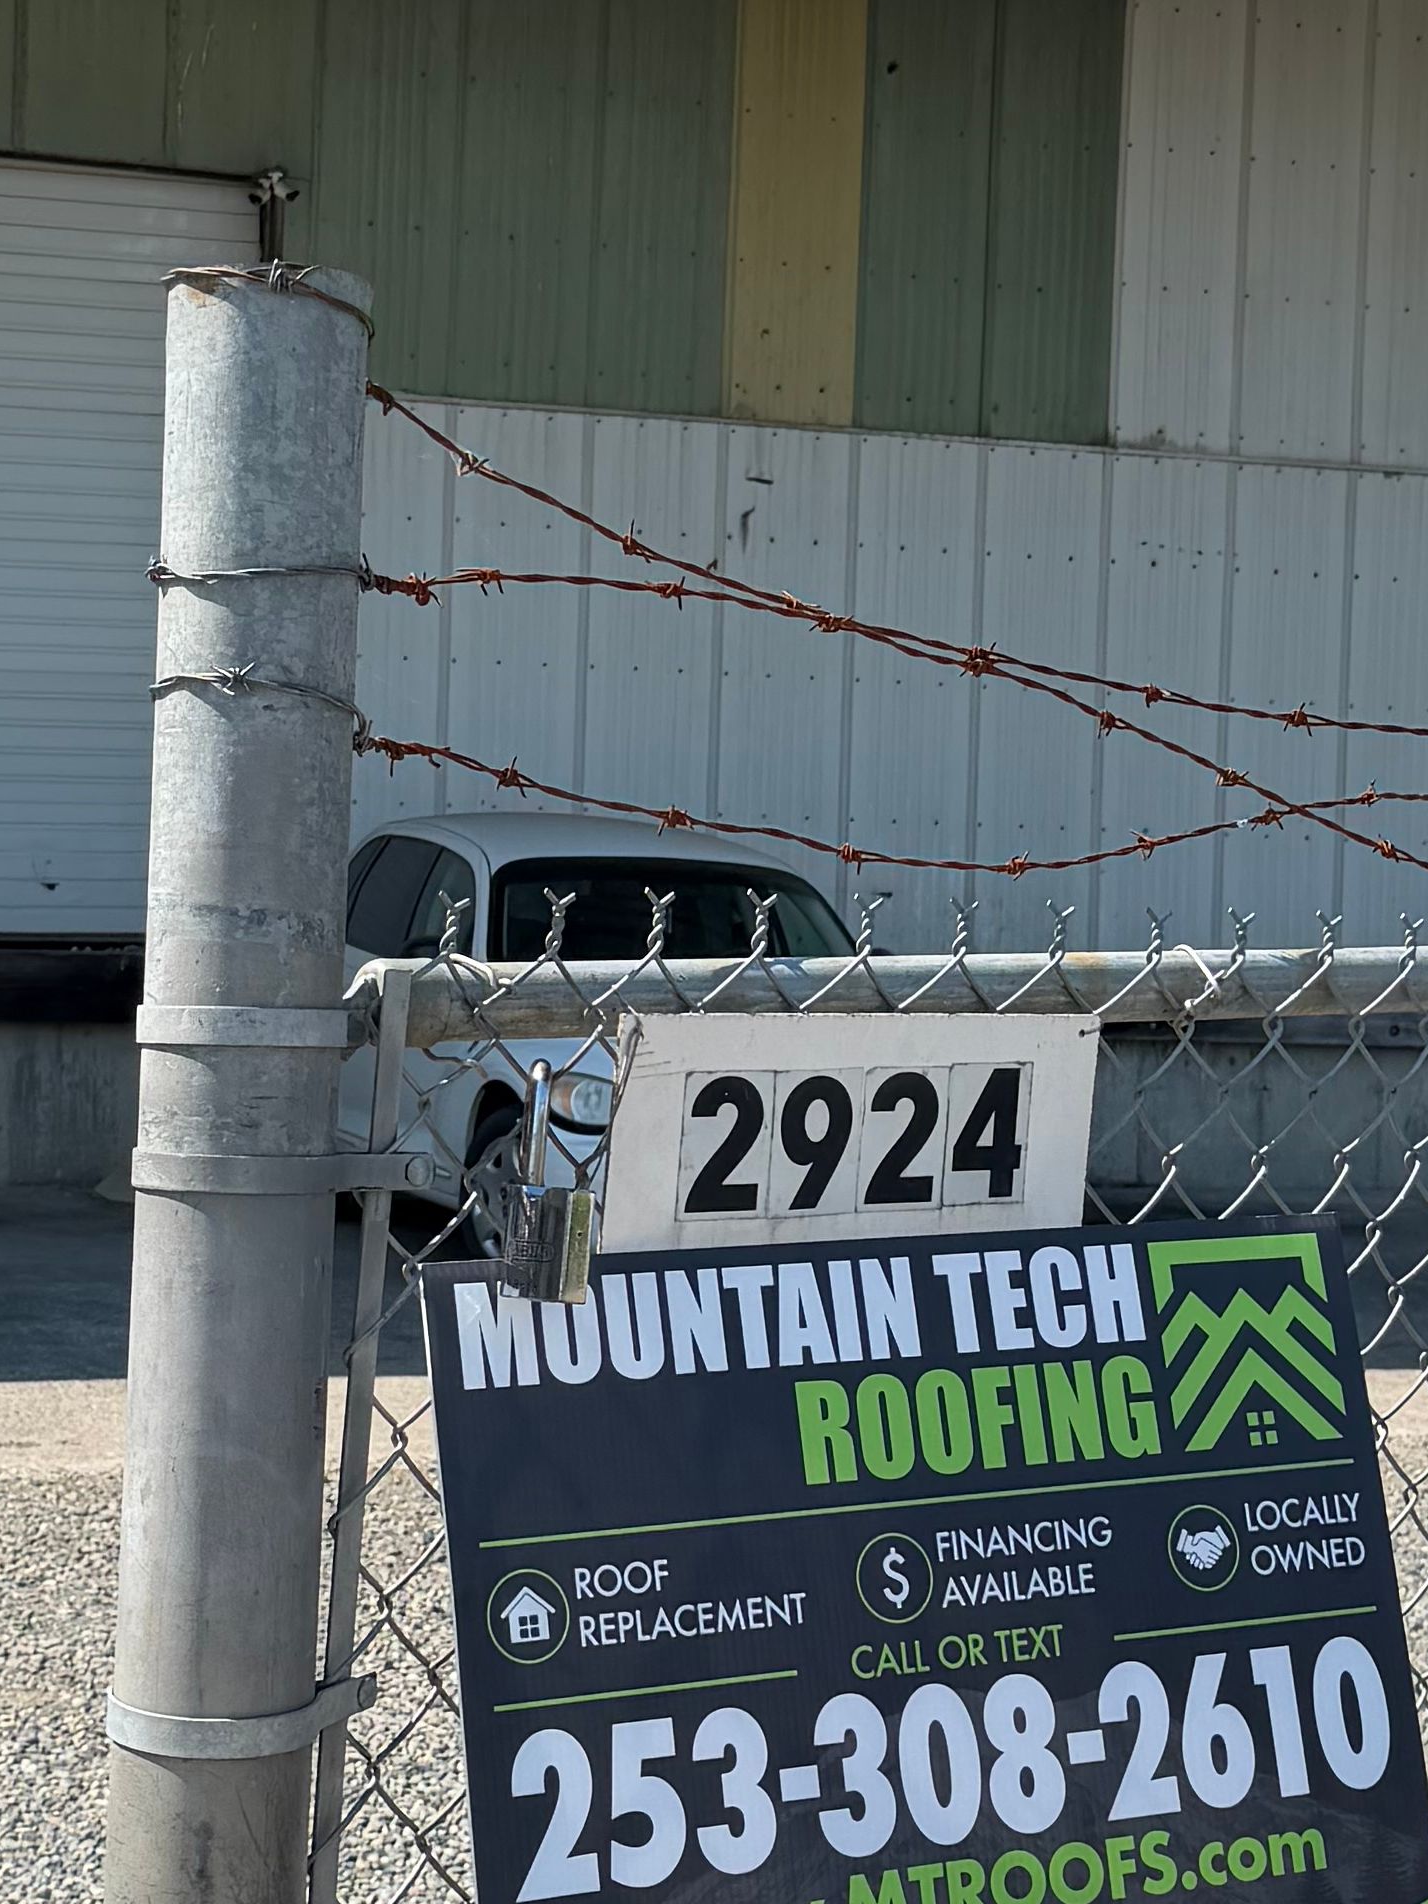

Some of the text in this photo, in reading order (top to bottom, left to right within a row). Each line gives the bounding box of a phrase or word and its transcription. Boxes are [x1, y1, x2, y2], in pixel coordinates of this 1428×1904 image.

[684, 1066, 1022, 1213] 2924
[452, 1243, 1147, 1390] MOUNTAIN TECH
[795, 1357, 1161, 1486] ROOFING
[1244, 1492, 1358, 1532] LOCALLY
[936, 1516, 1112, 1561] FINANCING
[1250, 1537, 1365, 1576] OWNED
[575, 1559, 668, 1596] ROOF
[942, 1563, 1095, 1608] AVAILABLE
[580, 1594, 806, 1646] REPLACEMENT
[850, 1626, 1063, 1679] CALL OR TEXT
[511, 1636, 1390, 1903] 253-308-2610
